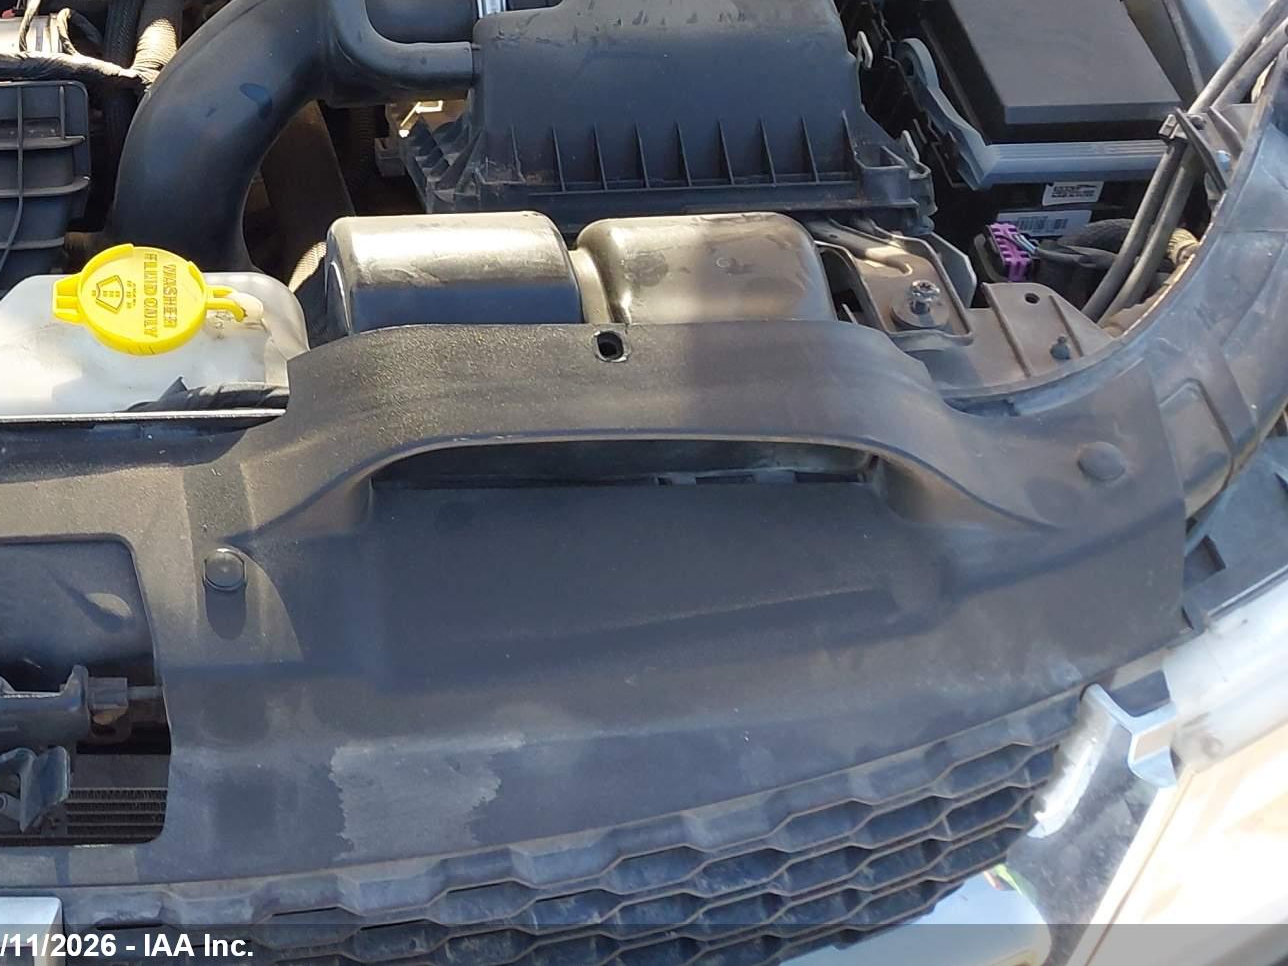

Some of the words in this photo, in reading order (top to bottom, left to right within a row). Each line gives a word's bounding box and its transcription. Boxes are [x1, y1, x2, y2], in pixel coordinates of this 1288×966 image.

[143, 252, 159, 296] FLUID
[162, 264, 178, 328] WASHER
[143, 297, 159, 338] ONLY
